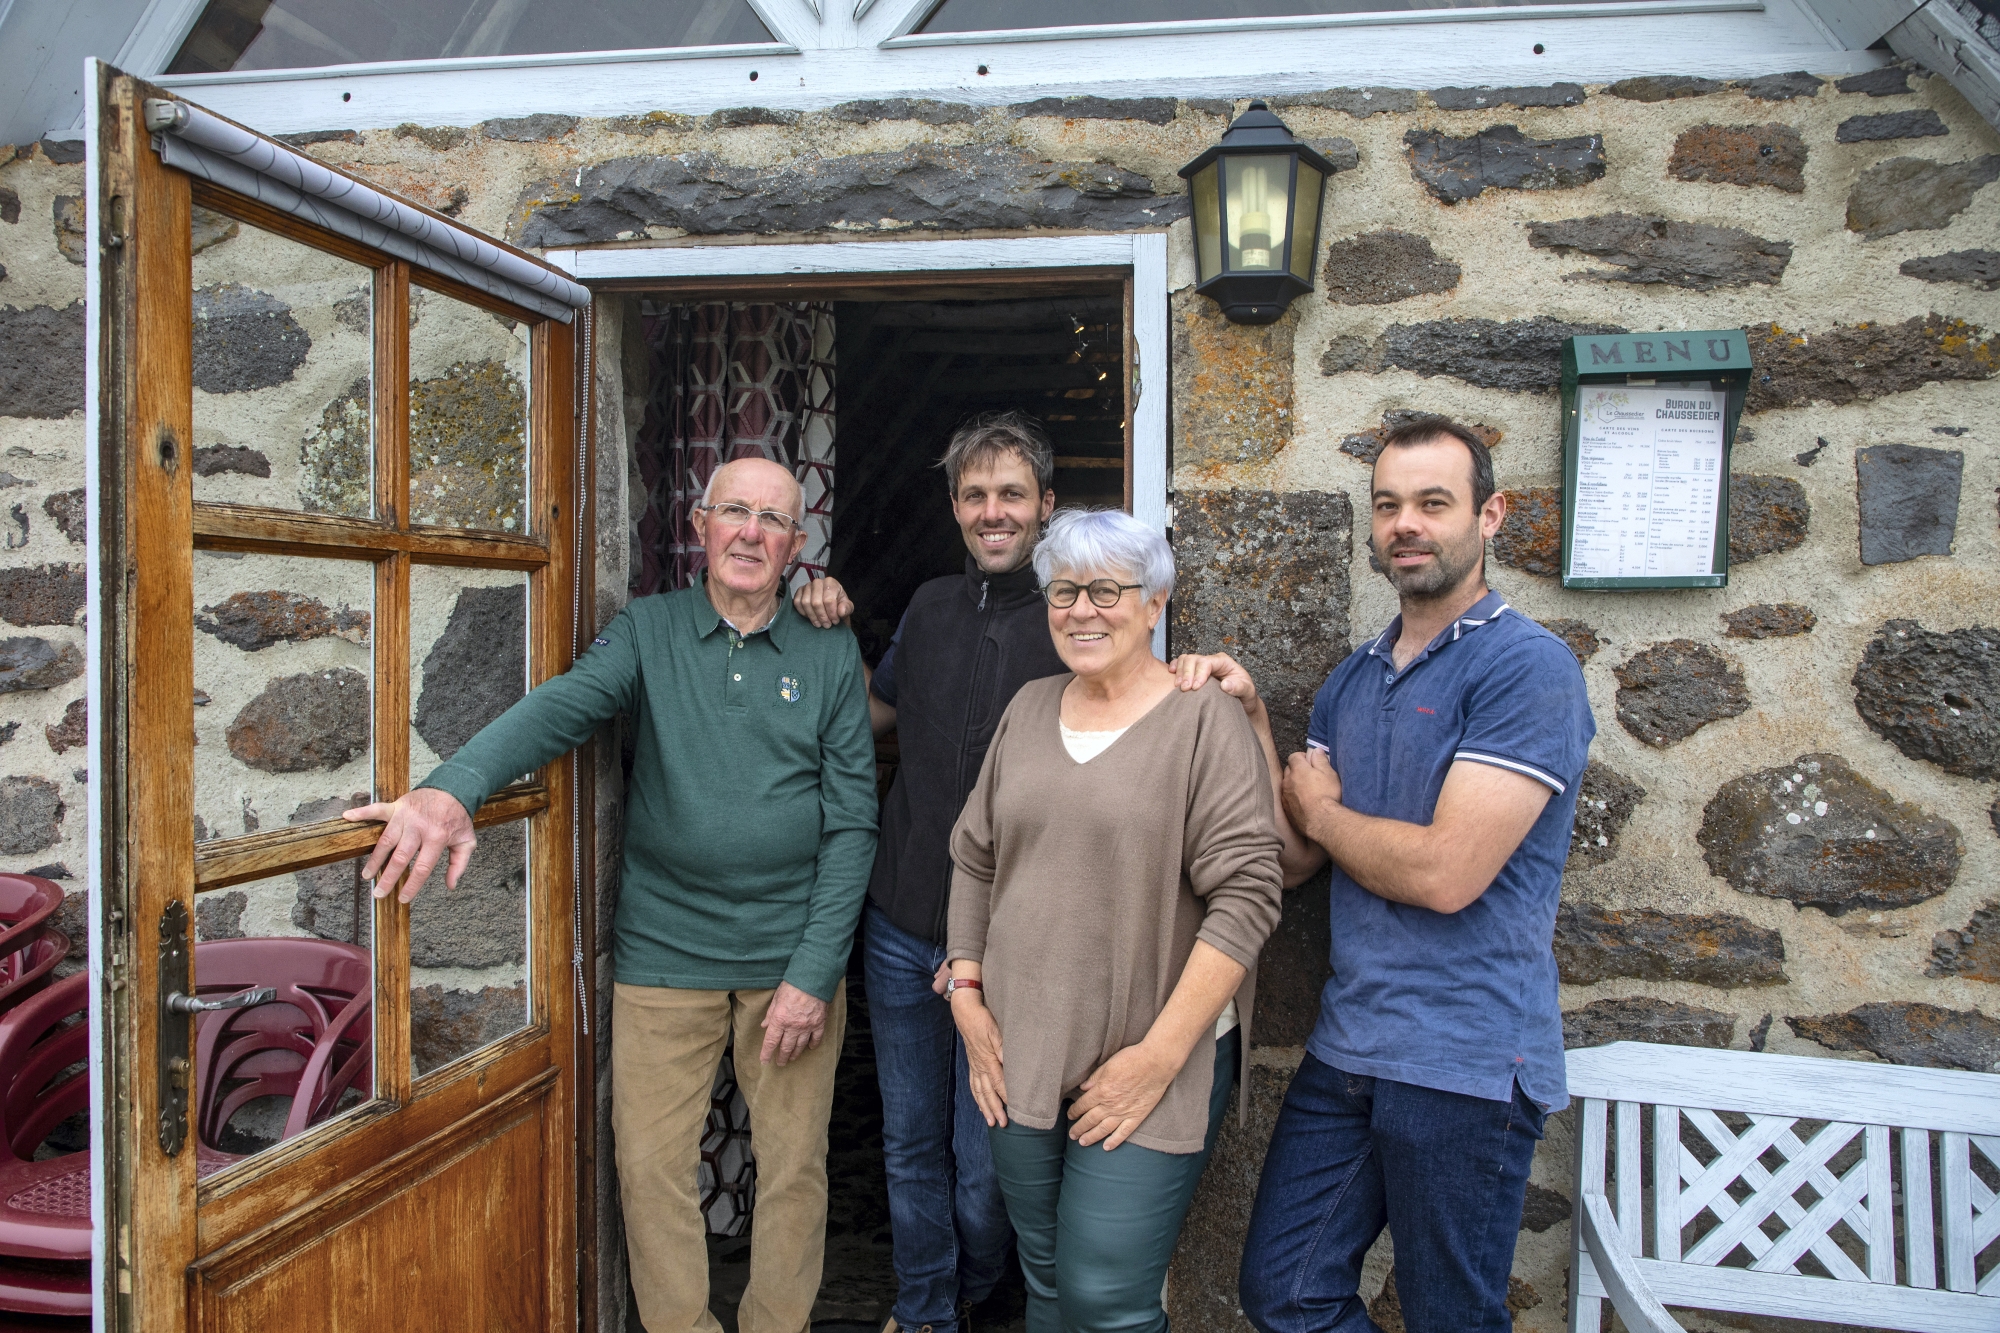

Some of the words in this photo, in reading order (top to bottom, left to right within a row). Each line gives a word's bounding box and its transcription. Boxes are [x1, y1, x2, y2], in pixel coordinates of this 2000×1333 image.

[1590, 339, 1730, 365] MENU
[1665, 398, 1696, 410] BURON
[1698, 400, 1711, 410] DU
[1655, 408, 1720, 421] CHAUSSEDIER
